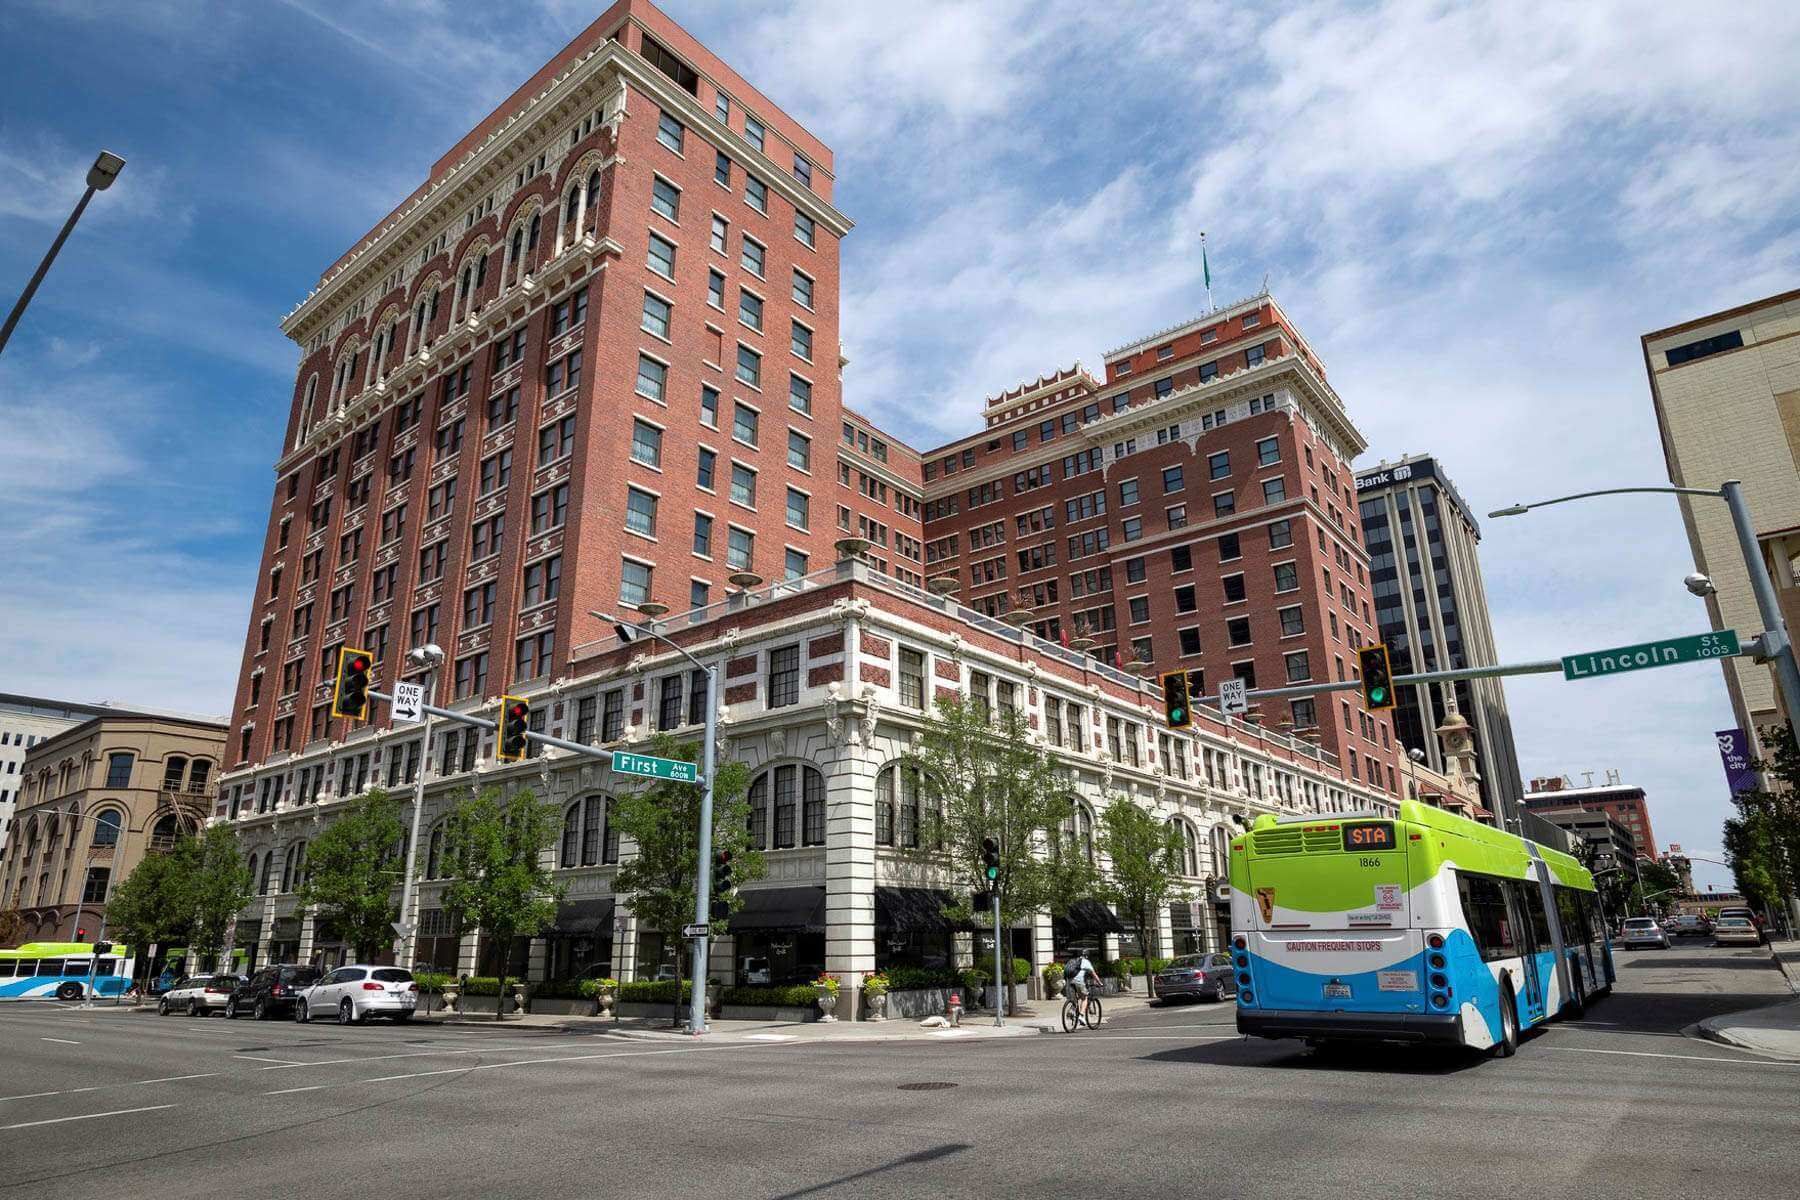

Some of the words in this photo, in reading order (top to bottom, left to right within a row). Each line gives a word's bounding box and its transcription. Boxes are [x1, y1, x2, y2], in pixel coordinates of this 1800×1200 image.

[1355, 473, 1390, 489] Bank
[1702, 635, 1720, 647] St
[1571, 646, 1679, 675] Lincoln
[399, 685, 419, 697] ONE
[1222, 681, 1241, 692] ONE
[397, 695, 419, 706] WAY
[1223, 690, 1242, 701] WAY
[1727, 754, 1743, 763] the
[621, 755, 658, 774] First
[672, 763, 688, 772] Ave
[1729, 761, 1747, 770] city
[1352, 827, 1386, 844] STA
[1360, 857, 1381, 867] 1866
[1287, 941, 1317, 951] CAUTION
[1318, 941, 1355, 951] FREQUENT
[1357, 941, 1381, 951] STOPS
